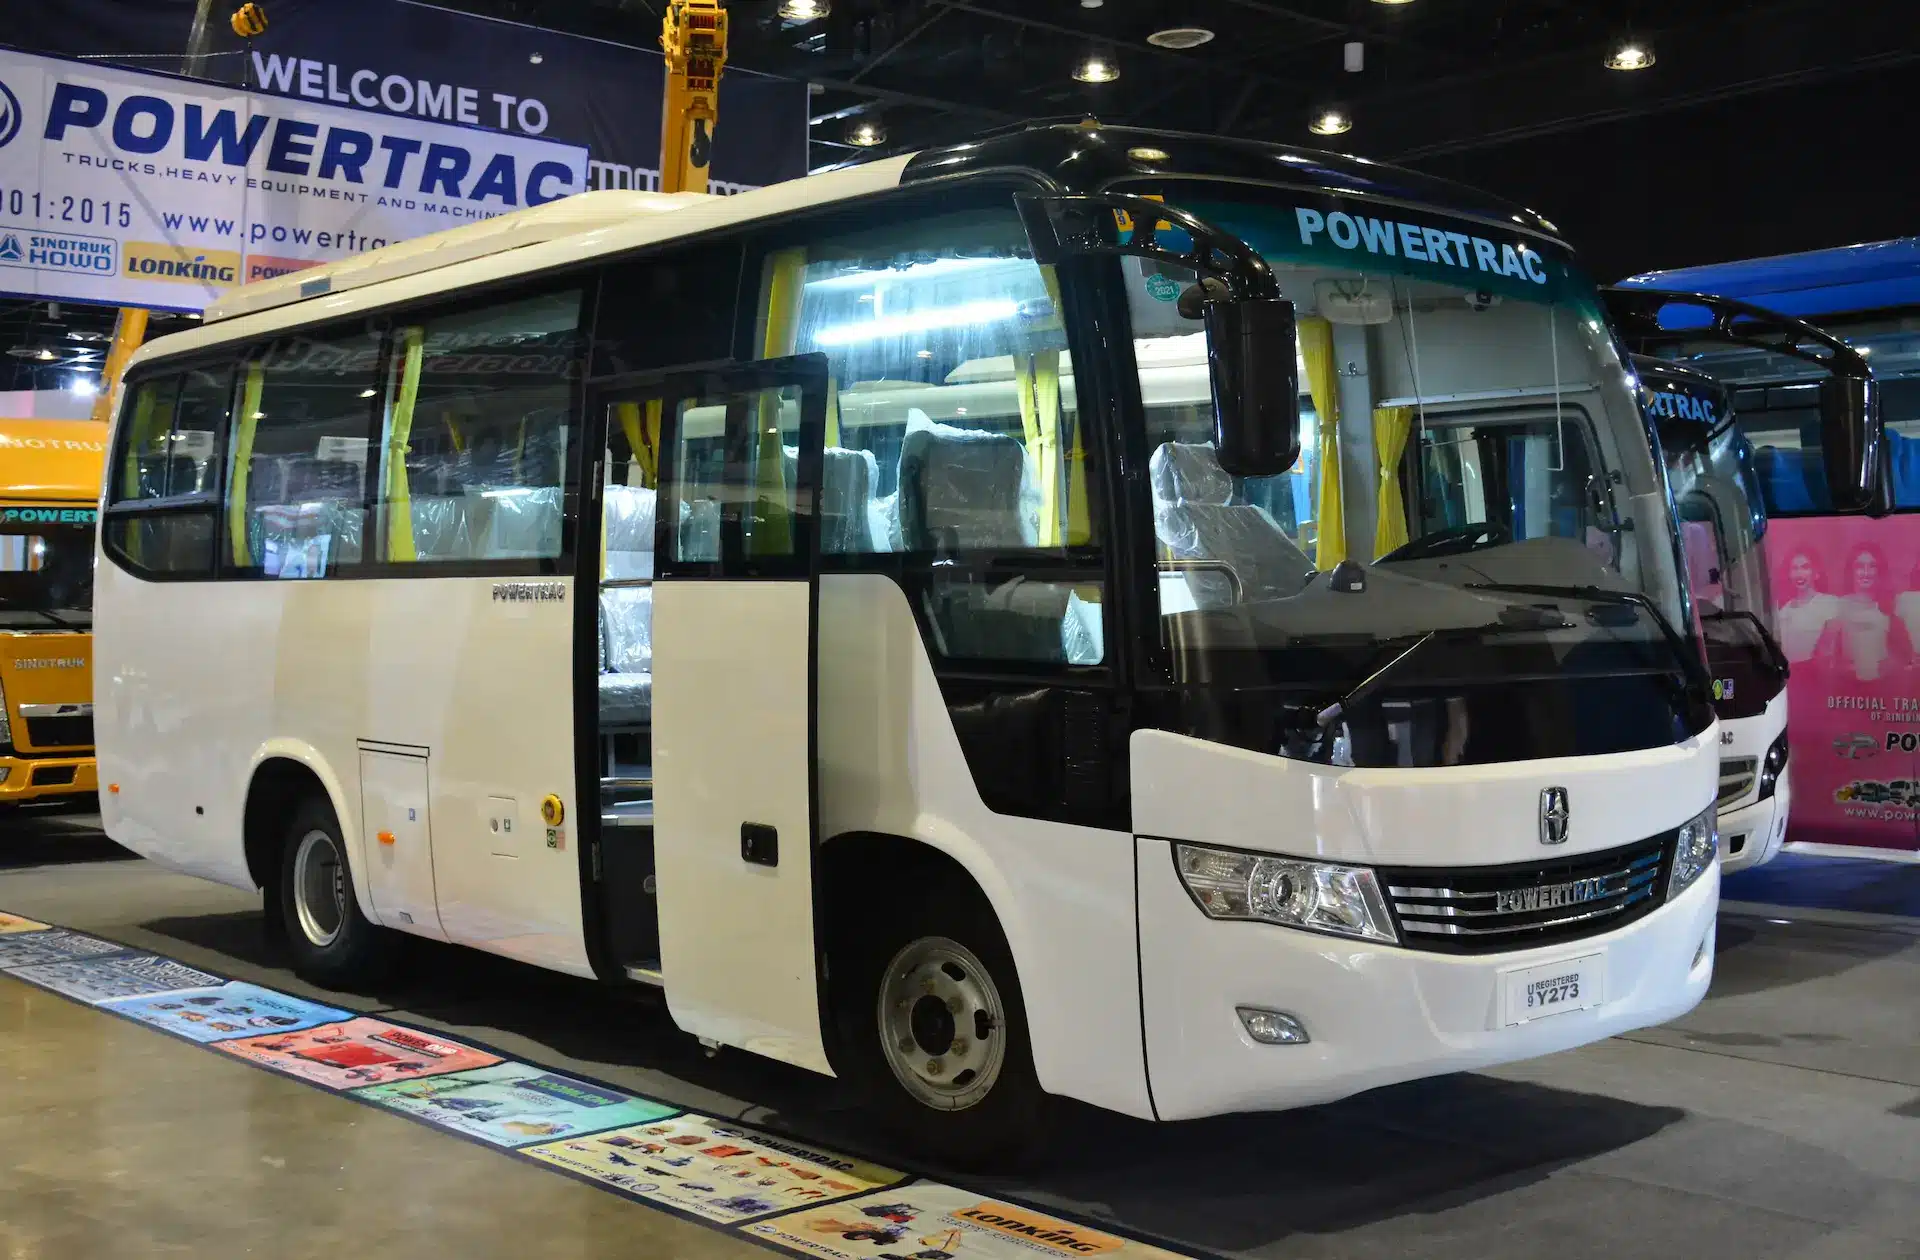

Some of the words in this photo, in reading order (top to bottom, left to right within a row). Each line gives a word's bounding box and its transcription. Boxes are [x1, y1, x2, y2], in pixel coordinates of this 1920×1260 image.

[252, 51, 479, 125] WELCOME
[493, 93, 549, 135] TO
[44, 82, 574, 208] POWERTRAC
[246, 177, 368, 204] EQUIPMENT
[377, 196, 417, 210] AND
[424, 202, 506, 220] MACHIN
[0, 189, 131, 228] 01:2015
[163, 212, 402, 252] www.powertra
[30, 236, 111, 255] SINOTRUK
[1295, 207, 1546, 285] POWERTRAC
[29, 249, 111, 271] HOWO
[1155, 285, 1175, 296] 2021
[492, 582, 566, 601] POWERTRAC
[15, 658, 85, 670] SINOTRUK
[1827, 696, 1887, 710] OFFICIAL
[1886, 731, 1920, 753] PO
[1496, 876, 1608, 913] POWERTRAC
[1536, 974, 1579, 989] REGISTERED
[1537, 983, 1580, 1006] Y273
[744, 1135, 855, 1171] POWERTRAC
